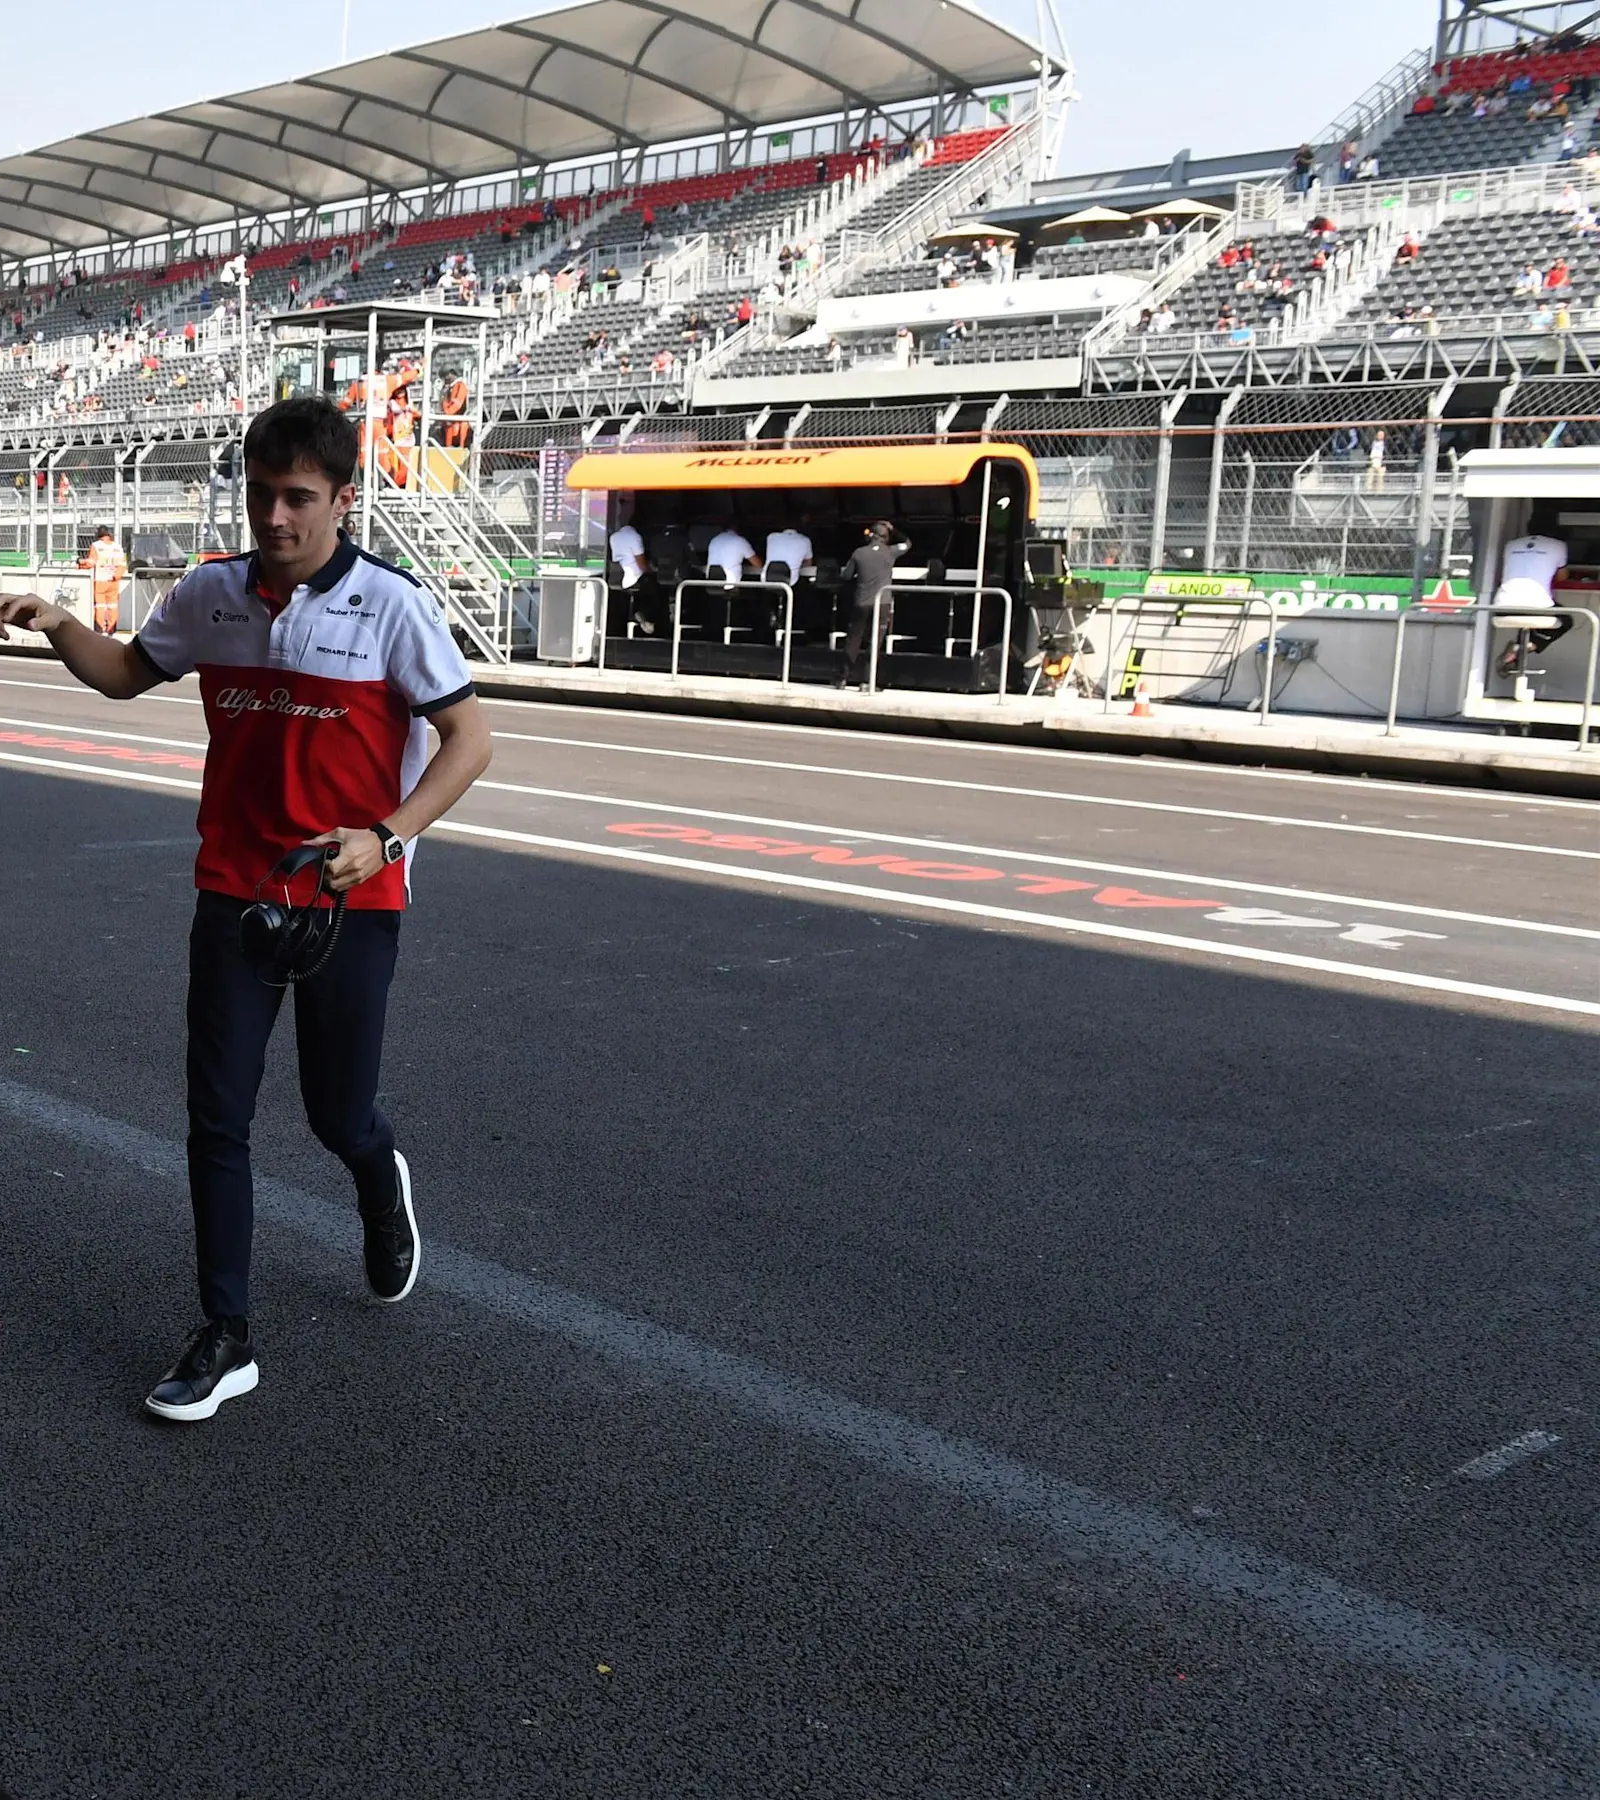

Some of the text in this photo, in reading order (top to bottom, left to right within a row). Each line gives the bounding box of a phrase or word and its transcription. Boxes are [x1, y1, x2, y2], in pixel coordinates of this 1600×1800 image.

[685, 457, 812, 467] McLaren
[1168, 583, 1222, 596] LANDO
[216, 688, 349, 719] Alfa Romeo
[604, 821, 1229, 909] ALONSO
